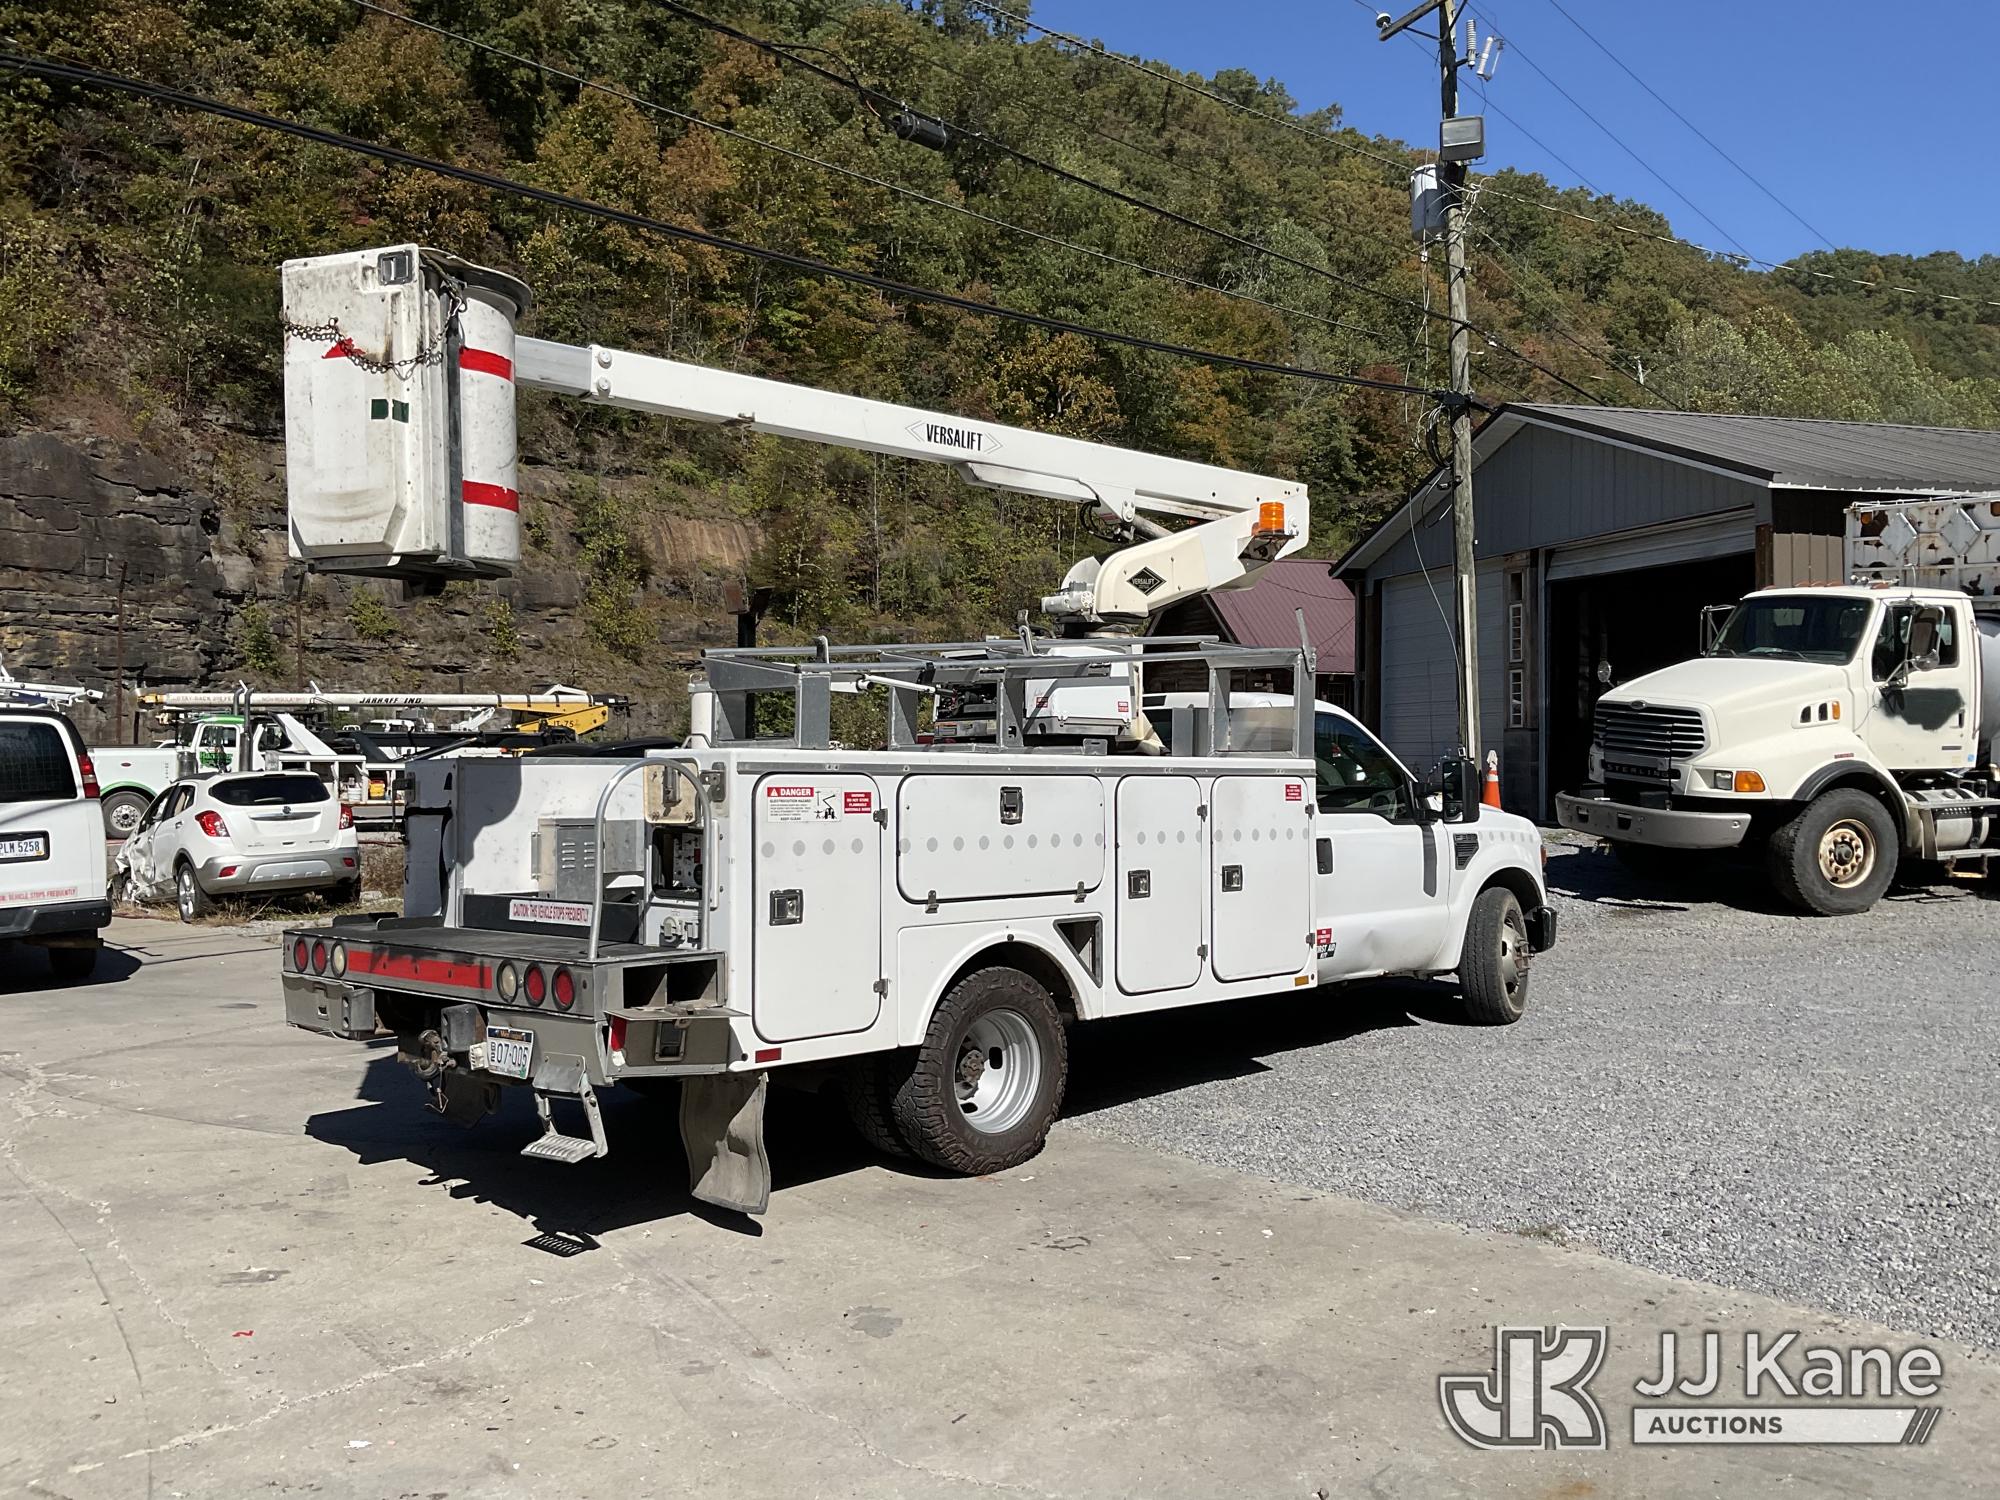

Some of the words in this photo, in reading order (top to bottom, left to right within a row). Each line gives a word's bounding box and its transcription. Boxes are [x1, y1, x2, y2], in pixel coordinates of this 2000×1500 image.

[926, 423, 983, 451] VERSALIFT
[1607, 764, 1669, 778] STERLING
[780, 788, 811, 796] DANGER
[17, 840, 40, 853] 5258
[529, 904, 538, 918] THIS
[538, 905, 553, 919] VEHICLE
[552, 905, 565, 920] STOPS
[565, 907, 589, 922] FREQUENTLY
